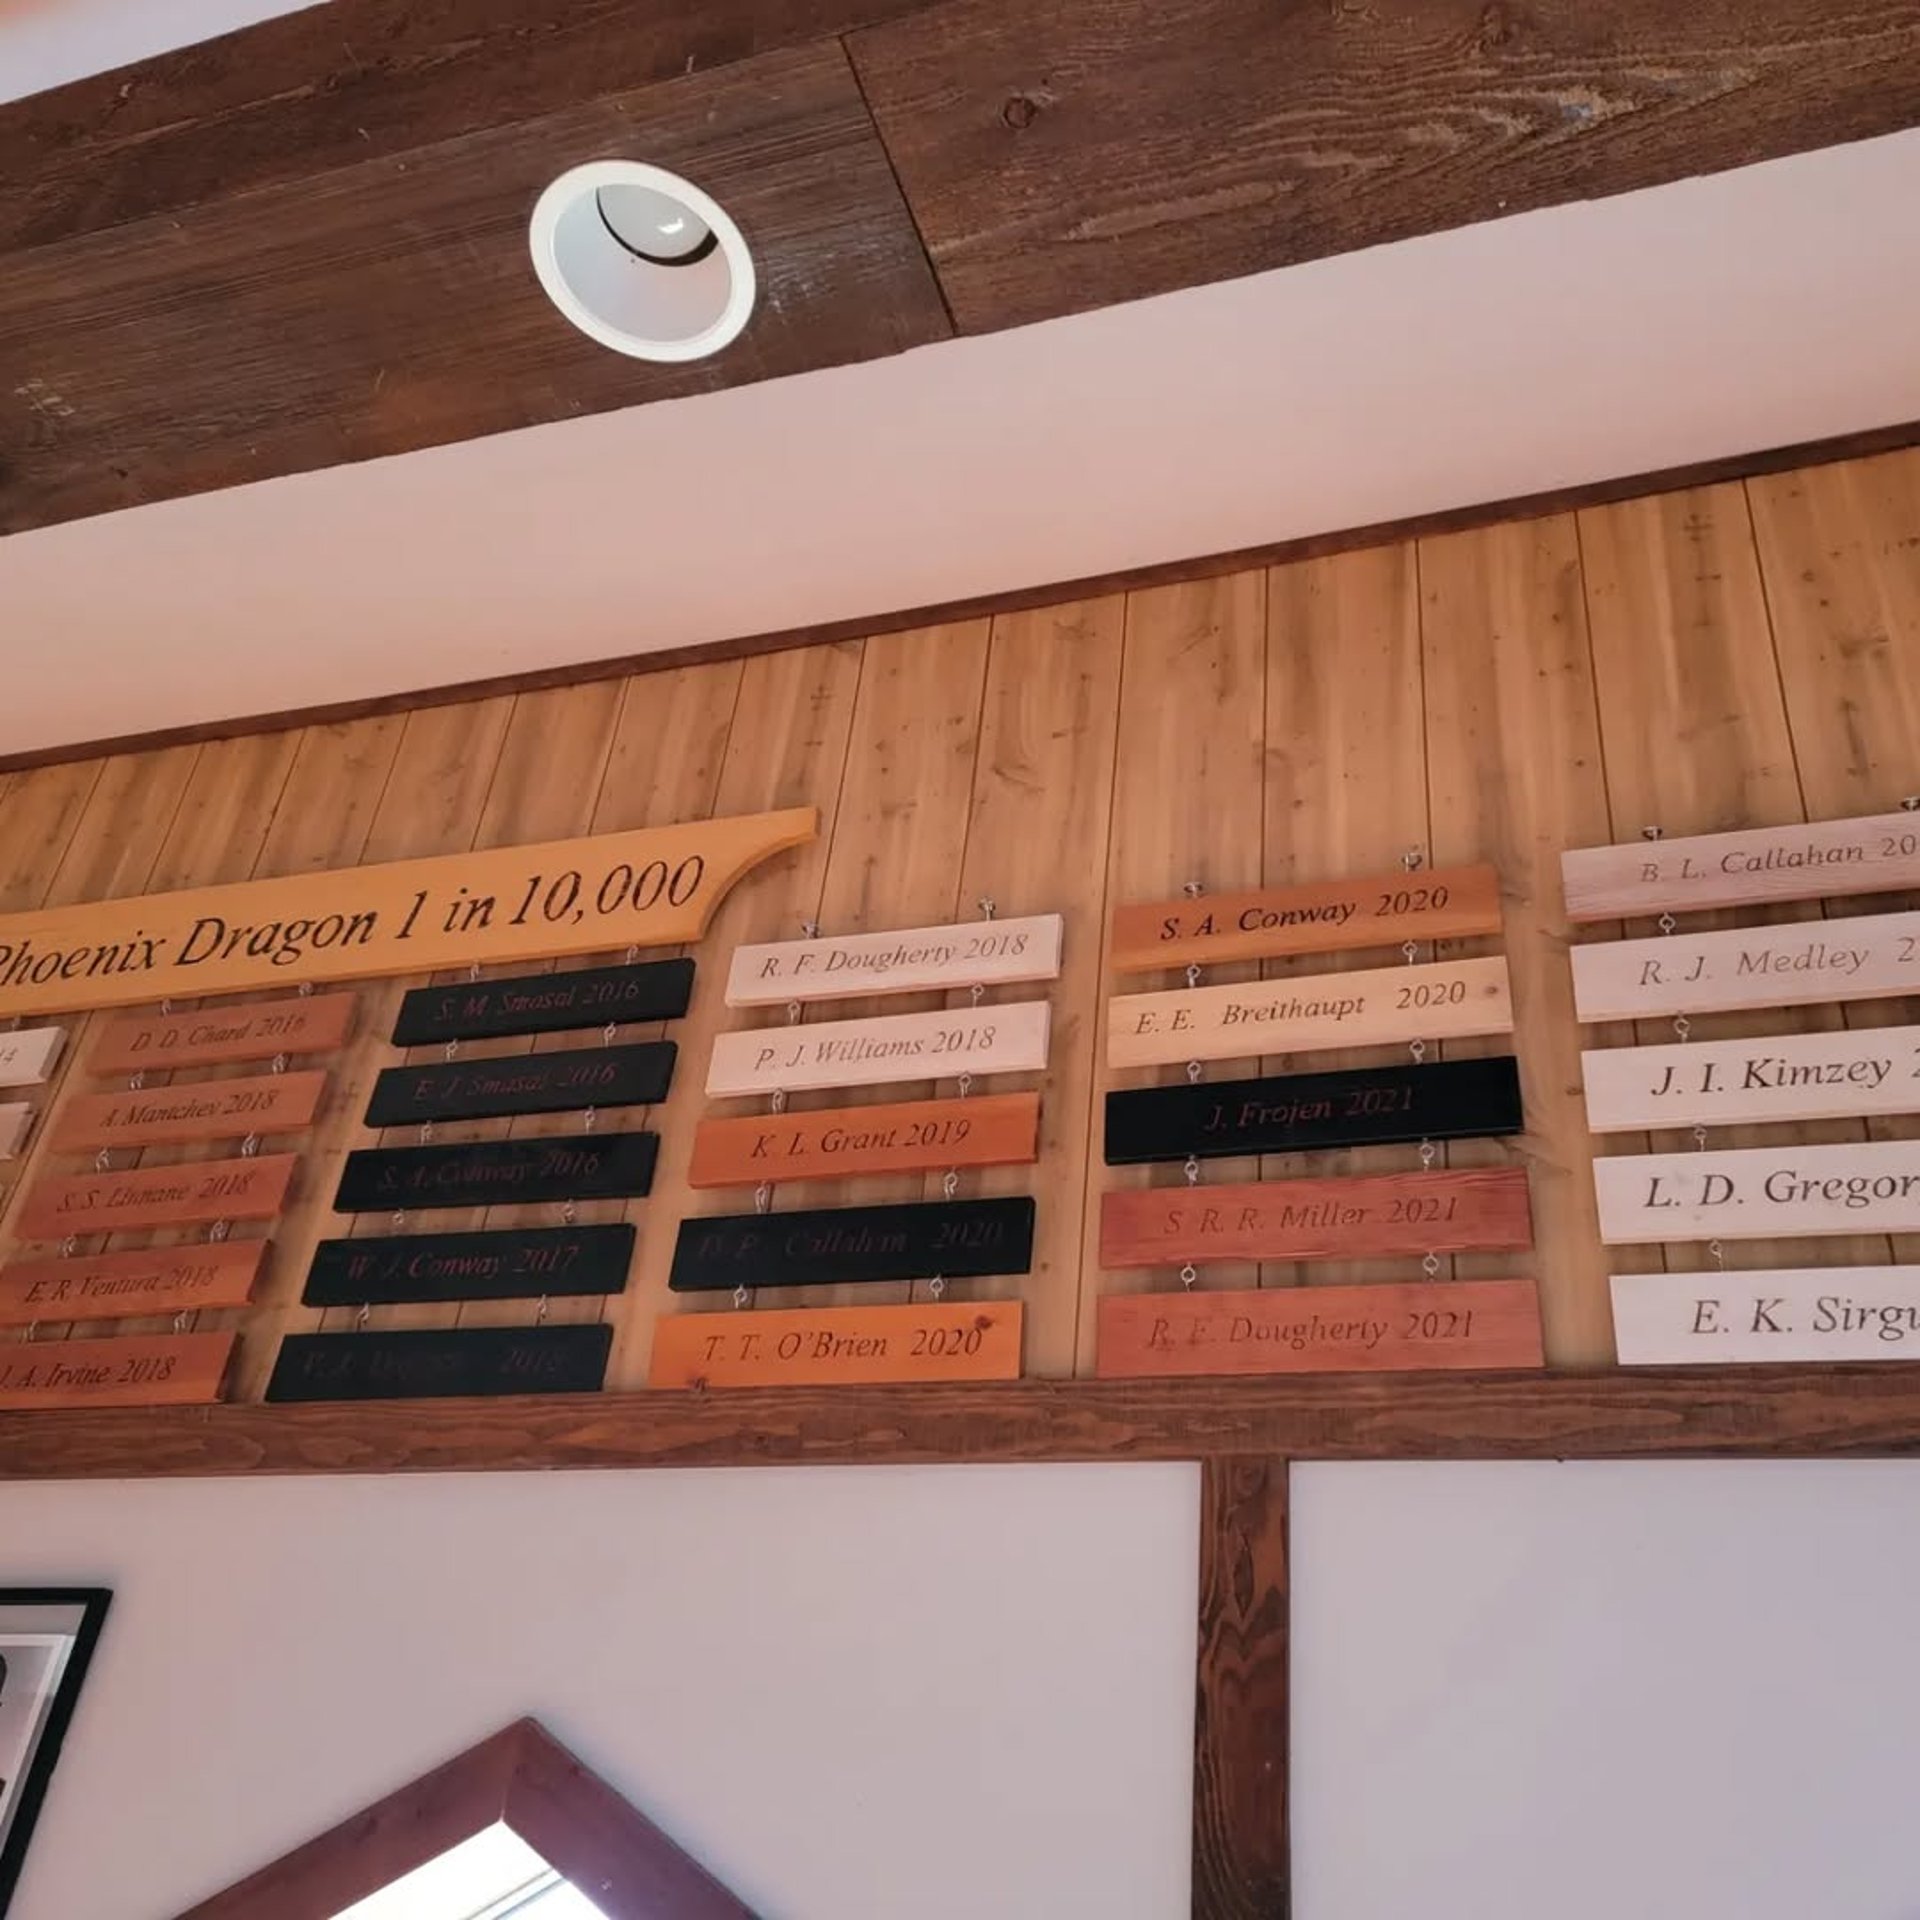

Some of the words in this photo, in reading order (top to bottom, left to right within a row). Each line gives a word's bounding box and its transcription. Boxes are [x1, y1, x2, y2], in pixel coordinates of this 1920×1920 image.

[1681, 858, 1707, 880] L.
[1720, 844, 1864, 875] Callahan
[172, 911, 378, 967] Dragon
[394, 891, 429, 939] 1
[443, 887, 497, 934] in
[509, 855, 705, 926] 10,000
[1159, 917, 1182, 941] S.
[1192, 914, 1221, 938] A.
[1238, 900, 1357, 932] Conway
[1374, 884, 1449, 918] 2020
[760, 957, 783, 979] R.
[793, 952, 817, 974] F.
[825, 944, 957, 974] Dougherty
[963, 933, 1029, 960] 2018
[1639, 960, 1670, 986] R.
[1684, 955, 1712, 982] J.
[1736, 943, 1870, 976] Medley
[1136, 1012, 1160, 1035] E.
[1171, 1008, 1196, 1031] E.
[1221, 995, 1367, 1027] Breithaupt
[1395, 980, 1467, 1011] 2020
[755, 1048, 777, 1071] P.
[786, 1046, 807, 1067] J.
[816, 1037, 925, 1065] Williams
[931, 1025, 997, 1054] 2018
[1650, 1066, 1683, 1096] J.
[1699, 1063, 1725, 1093] I.
[1740, 1057, 1892, 1090] Kimzey
[223, 1089, 280, 1115] 2018
[1204, 1104, 1228, 1132] J.
[1236, 1093, 1333, 1129] Frojen
[1345, 1084, 1413, 1117] 2021
[821, 1126, 897, 1155] Grant
[903, 1118, 972, 1147] 2019
[199, 1172, 257, 1199] 2018
[1644, 1176, 1681, 1208] L.
[1698, 1173, 1744, 1207] D.
[1764, 1170, 1920, 1208] Gregor
[1279, 1202, 1373, 1230] Miller
[1387, 1195, 1458, 1224] 2021
[510, 1243, 581, 1274] 2017
[163, 1265, 220, 1291] 2018
[1229, 1313, 1389, 1351] Dougherty
[1401, 1310, 1476, 1342] 2021
[1691, 1298, 1730, 1334] E.
[1749, 1297, 1793, 1334] K.
[739, 1333, 762, 1361] T.
[909, 1327, 983, 1356] 2020
[15, 1365, 38, 1388] A.
[45, 1362, 112, 1387] Irvine
[117, 1357, 177, 1382] 2018
